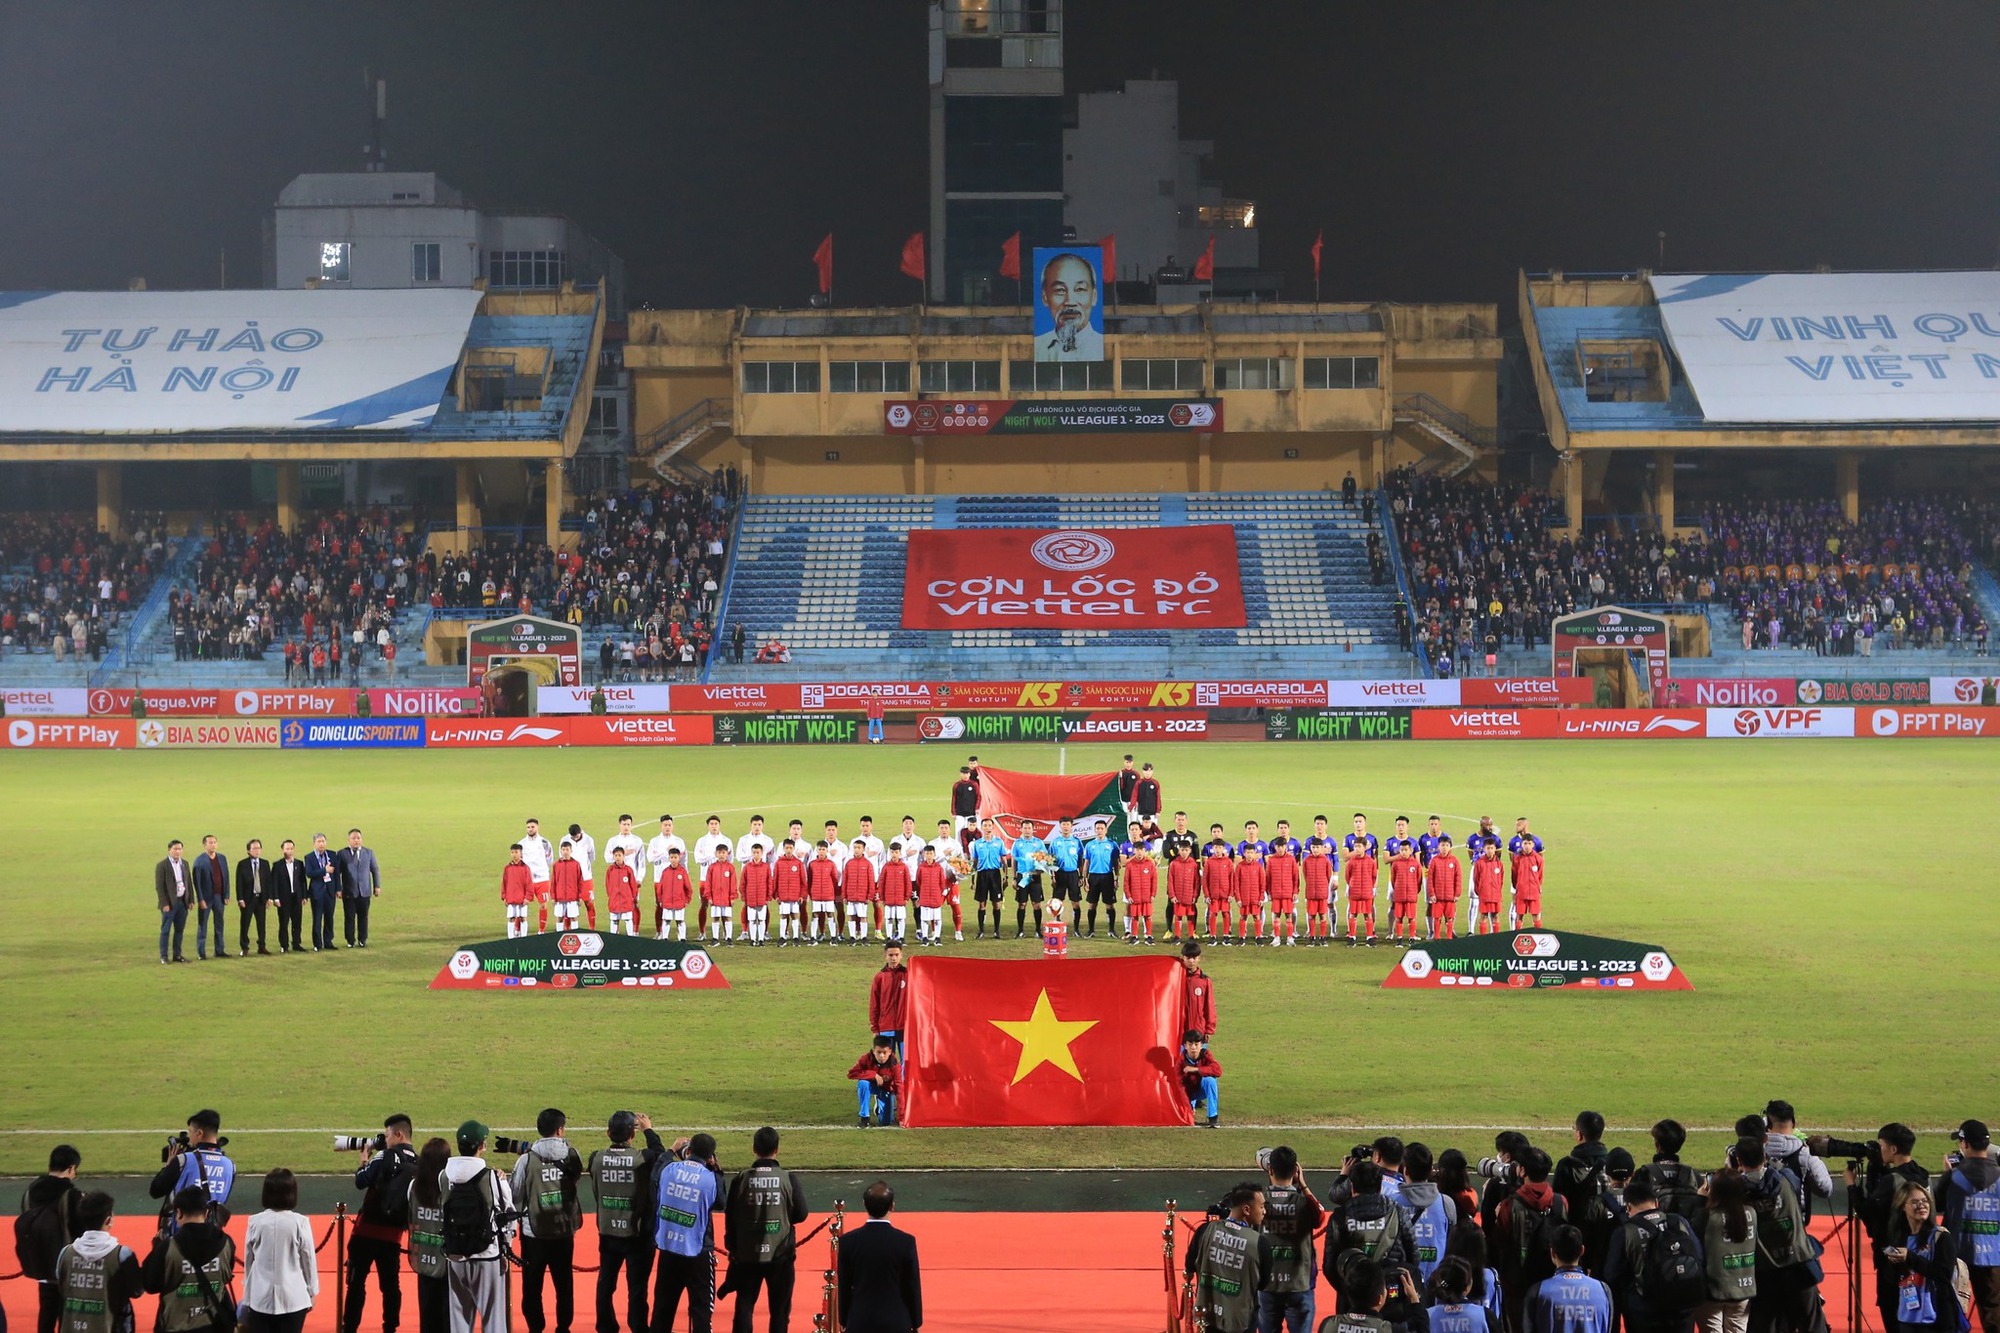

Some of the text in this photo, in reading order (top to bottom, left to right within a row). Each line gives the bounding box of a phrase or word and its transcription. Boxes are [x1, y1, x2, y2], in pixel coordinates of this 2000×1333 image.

[1715, 314, 1898, 341] VINH
[61, 326, 159, 359] TỰ
[1785, 345, 1950, 388] VIỆT
[161, 358, 301, 400] NỘI
[1043, 405, 1063, 414] BÓNG
[1107, 404, 1128, 413] QUỐC
[1004, 414, 1165, 429] NIGHT WOLF V.LEAGUE 1 2023
[928, 570, 1220, 598] CƠN LỐC ĐỎ
[938, 596, 1211, 616] viettel FC
[704, 686, 767, 699] viettel
[824, 684, 930, 696] JOGARBOLA
[972, 686, 997, 700] NGỌC
[999, 686, 1021, 696] LINH
[1016, 682, 1064, 706] K5
[1103, 685, 1130, 699] NGỌC
[1131, 685, 1153, 695] LINH
[1148, 682, 1195, 706] K5
[1219, 683, 1326, 695] JOGARBOLA
[1362, 682, 1426, 696] viettel
[1495, 679, 1559, 693] viettel
[1696, 682, 1778, 705] Noliko
[1824, 681, 1929, 702] BIA GOLD STAR
[262, 694, 335, 713] FPT Play
[385, 692, 462, 714] Noliko
[734, 701, 752, 709] your
[605, 717, 675, 733] viettel
[966, 716, 1014, 740] NIGHT
[1019, 716, 1062, 740] WOLF
[1062, 720, 1143, 733] V.LEAGUE
[1144, 720, 1154, 732] 1
[1165, 720, 1207, 733] 2023
[1297, 716, 1351, 740] NIGHT
[1358, 716, 1409, 740] WOLF
[1450, 711, 1520, 727] viettel
[1566, 720, 1641, 732] LI-NING
[1764, 709, 1821, 729] VPF
[1903, 713, 1986, 735] FPT Play
[39, 725, 120, 746] FPT Play
[168, 721, 278, 744] BIA SAO VÀNG
[308, 724, 420, 743] DONGLUCSPORT.VN
[430, 730, 504, 742] LI-NING
[623, 735, 638, 743] Theo
[639, 734, 653, 743] cách
[665, 734, 677, 745] bạn
[744, 719, 799, 743] NIGHT
[806, 719, 856, 743] WOLF
[1509, 729, 1521, 737] bạn
[484, 957, 516, 976] NIGHT
[518, 957, 547, 976] WOLF
[550, 959, 621, 971] V.LEAGUE
[622, 959, 630, 970] 1
[640, 959, 677, 970] 2023
[1437, 957, 1469, 976] NIGHT
[1472, 957, 1502, 976] WOLF
[1506, 959, 1578, 971] V.LEAGUE
[1580, 960, 1588, 971] 1
[1599, 960, 1637, 972] 2023
[602, 1155, 633, 1167] PHOTO
[602, 1169, 635, 1183] 2023
[676, 1169, 700, 1185] TV/R
[748, 1176, 780, 1189] PHOTO
[666, 1182, 701, 1203] 2023
[1965, 1196, 2000, 1212] 2023
[1212, 1229, 1248, 1251] PHOTO
[421, 1254, 437, 1265] 216
[1209, 1245, 1245, 1270] 2023
[69, 1272, 104, 1290] 2023
[1738, 1278, 1753, 1288] 125
[1560, 1285, 1590, 1300] TV/R
[1555, 1304, 1595, 1322] 2023
[1440, 1317, 1470, 1332] TV/R
